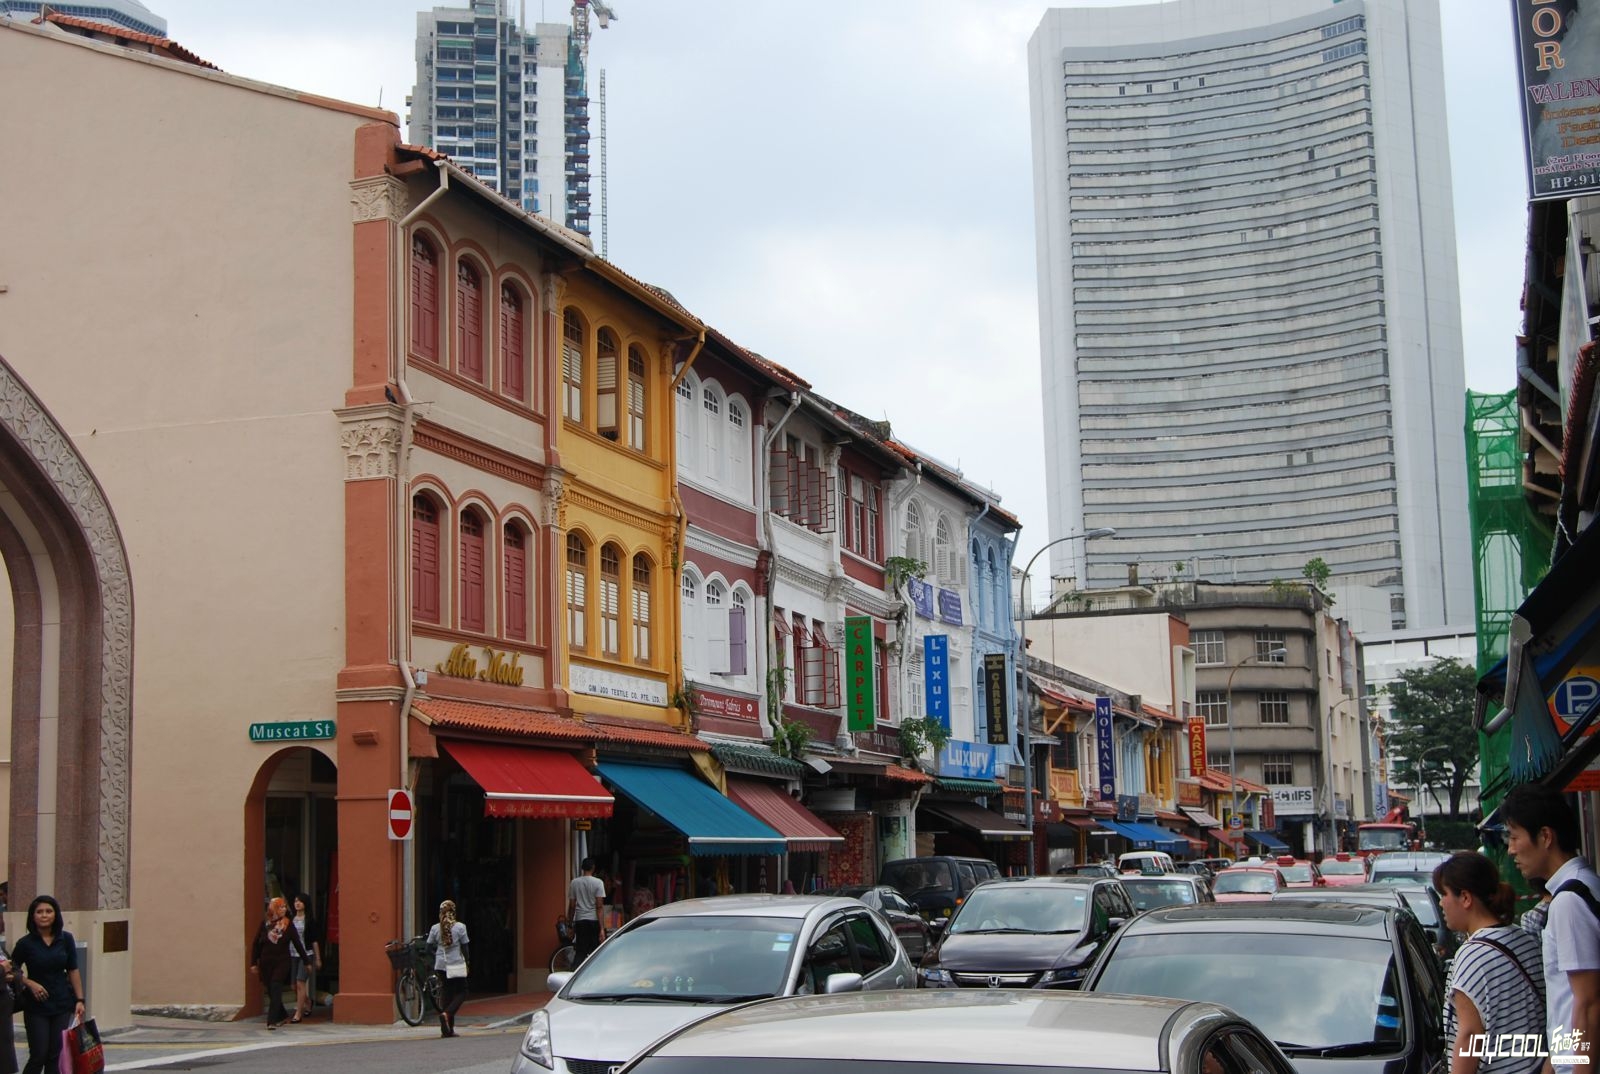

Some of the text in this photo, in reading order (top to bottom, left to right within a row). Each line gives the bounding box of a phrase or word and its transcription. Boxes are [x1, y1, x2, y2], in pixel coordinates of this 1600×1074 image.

[479, 646, 524, 687] Moda
[853, 628, 865, 721] CARPET
[611, 688, 629, 699] TEXTILE
[640, 694, 650, 702] PTE.
[652, 696, 661, 704] LTD.
[725, 698, 741, 712] Fabrics
[252, 722, 331, 738] Muscat St
[1099, 707, 1110, 771] MOLKAN
[948, 742, 988, 774] Luxury
[1192, 726, 1203, 775] CARPET
